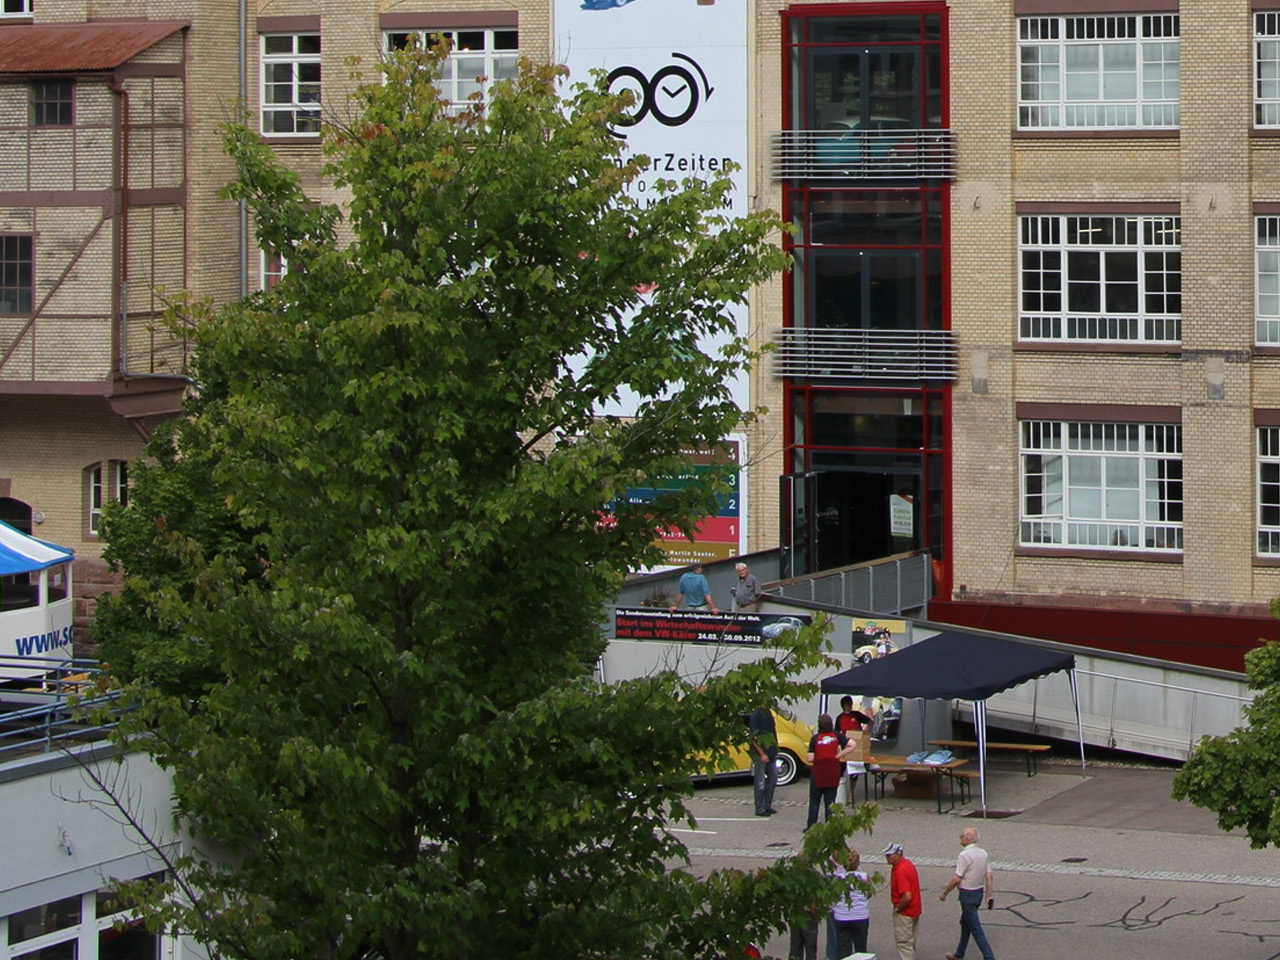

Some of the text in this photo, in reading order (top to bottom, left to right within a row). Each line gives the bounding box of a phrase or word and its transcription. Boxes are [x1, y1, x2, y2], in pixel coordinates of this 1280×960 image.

[728, 474, 736, 486] 3
[728, 499, 736, 510] 2
[729, 525, 735, 536] 1
[625, 610, 671, 619] Sonderausstellung
[616, 618, 742, 632] Start ins Wirtschaftswunder
[616, 629, 631, 637] mit
[633, 629, 652, 638] dem
[655, 630, 696, 640] VW-Käfer
[723, 634, 761, 642] 30.09.2012
